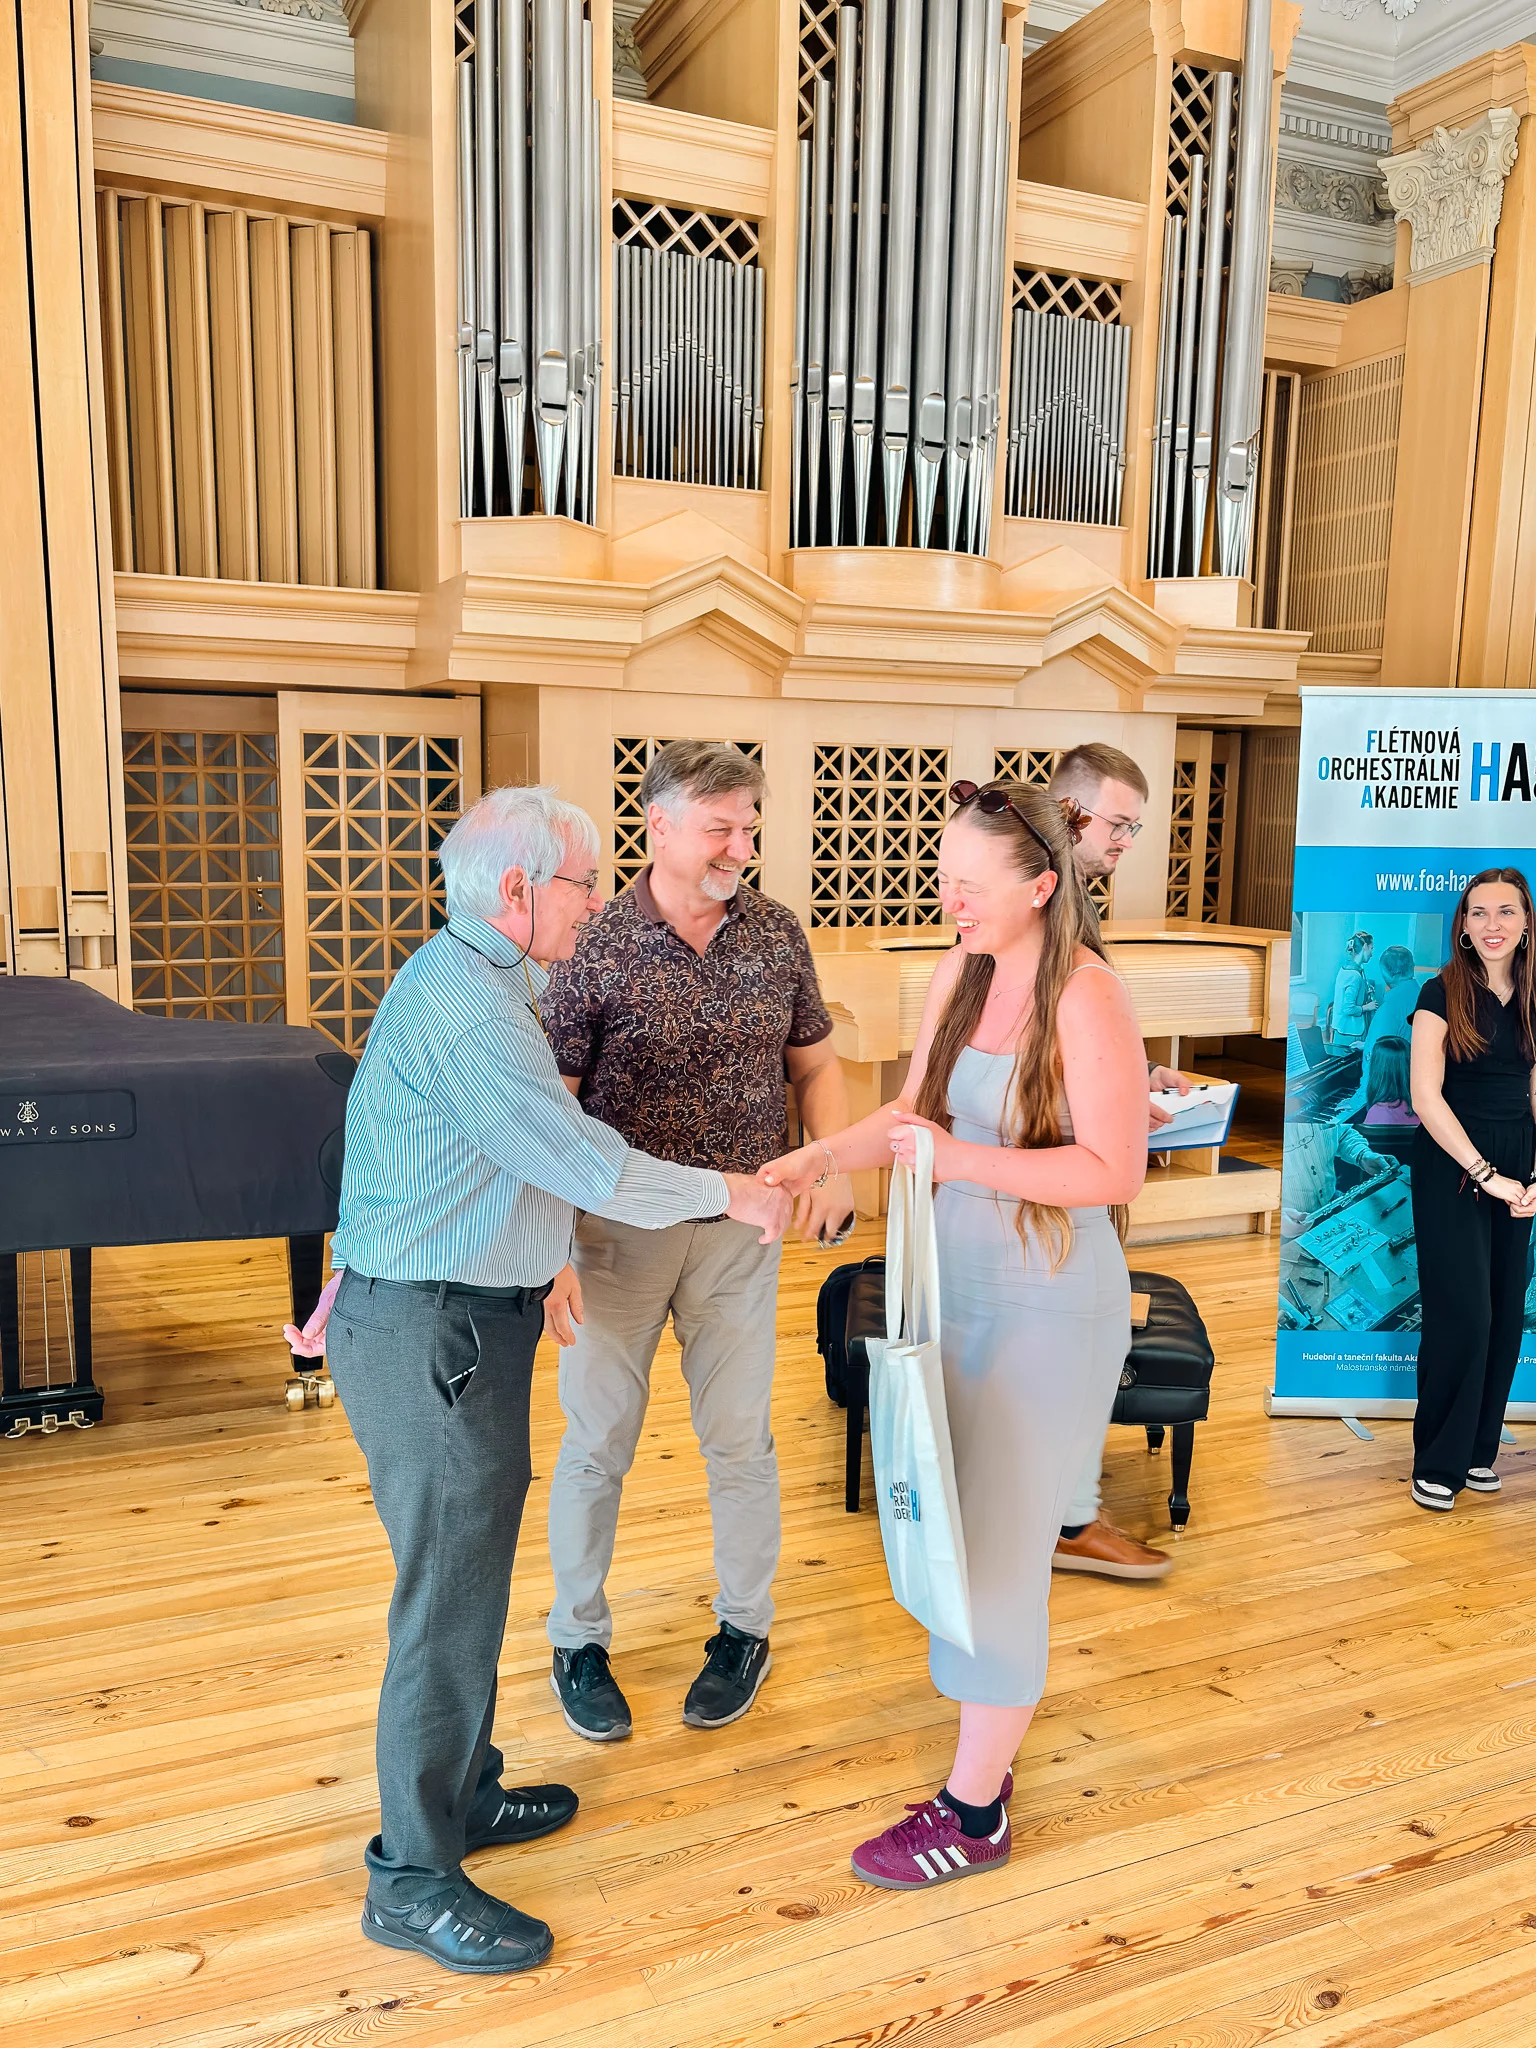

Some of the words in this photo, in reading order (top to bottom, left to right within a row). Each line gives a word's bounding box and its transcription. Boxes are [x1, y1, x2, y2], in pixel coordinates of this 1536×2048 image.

[1367, 726, 1460, 753] FLÉTNOVÁ
[1318, 754, 1461, 782] ORCHESTRÁLNÍ
[1470, 743, 1536, 802] HA
[1361, 785, 1459, 809] AKADEMIE
[50, 1126, 58, 1135] &
[70, 1123, 117, 1134] SONS
[1302, 1352, 1336, 1361] Hudební
[1344, 1353, 1374, 1362] taneční
[1375, 1353, 1403, 1362] fakulta
[1336, 1363, 1388, 1372] Malostranské
